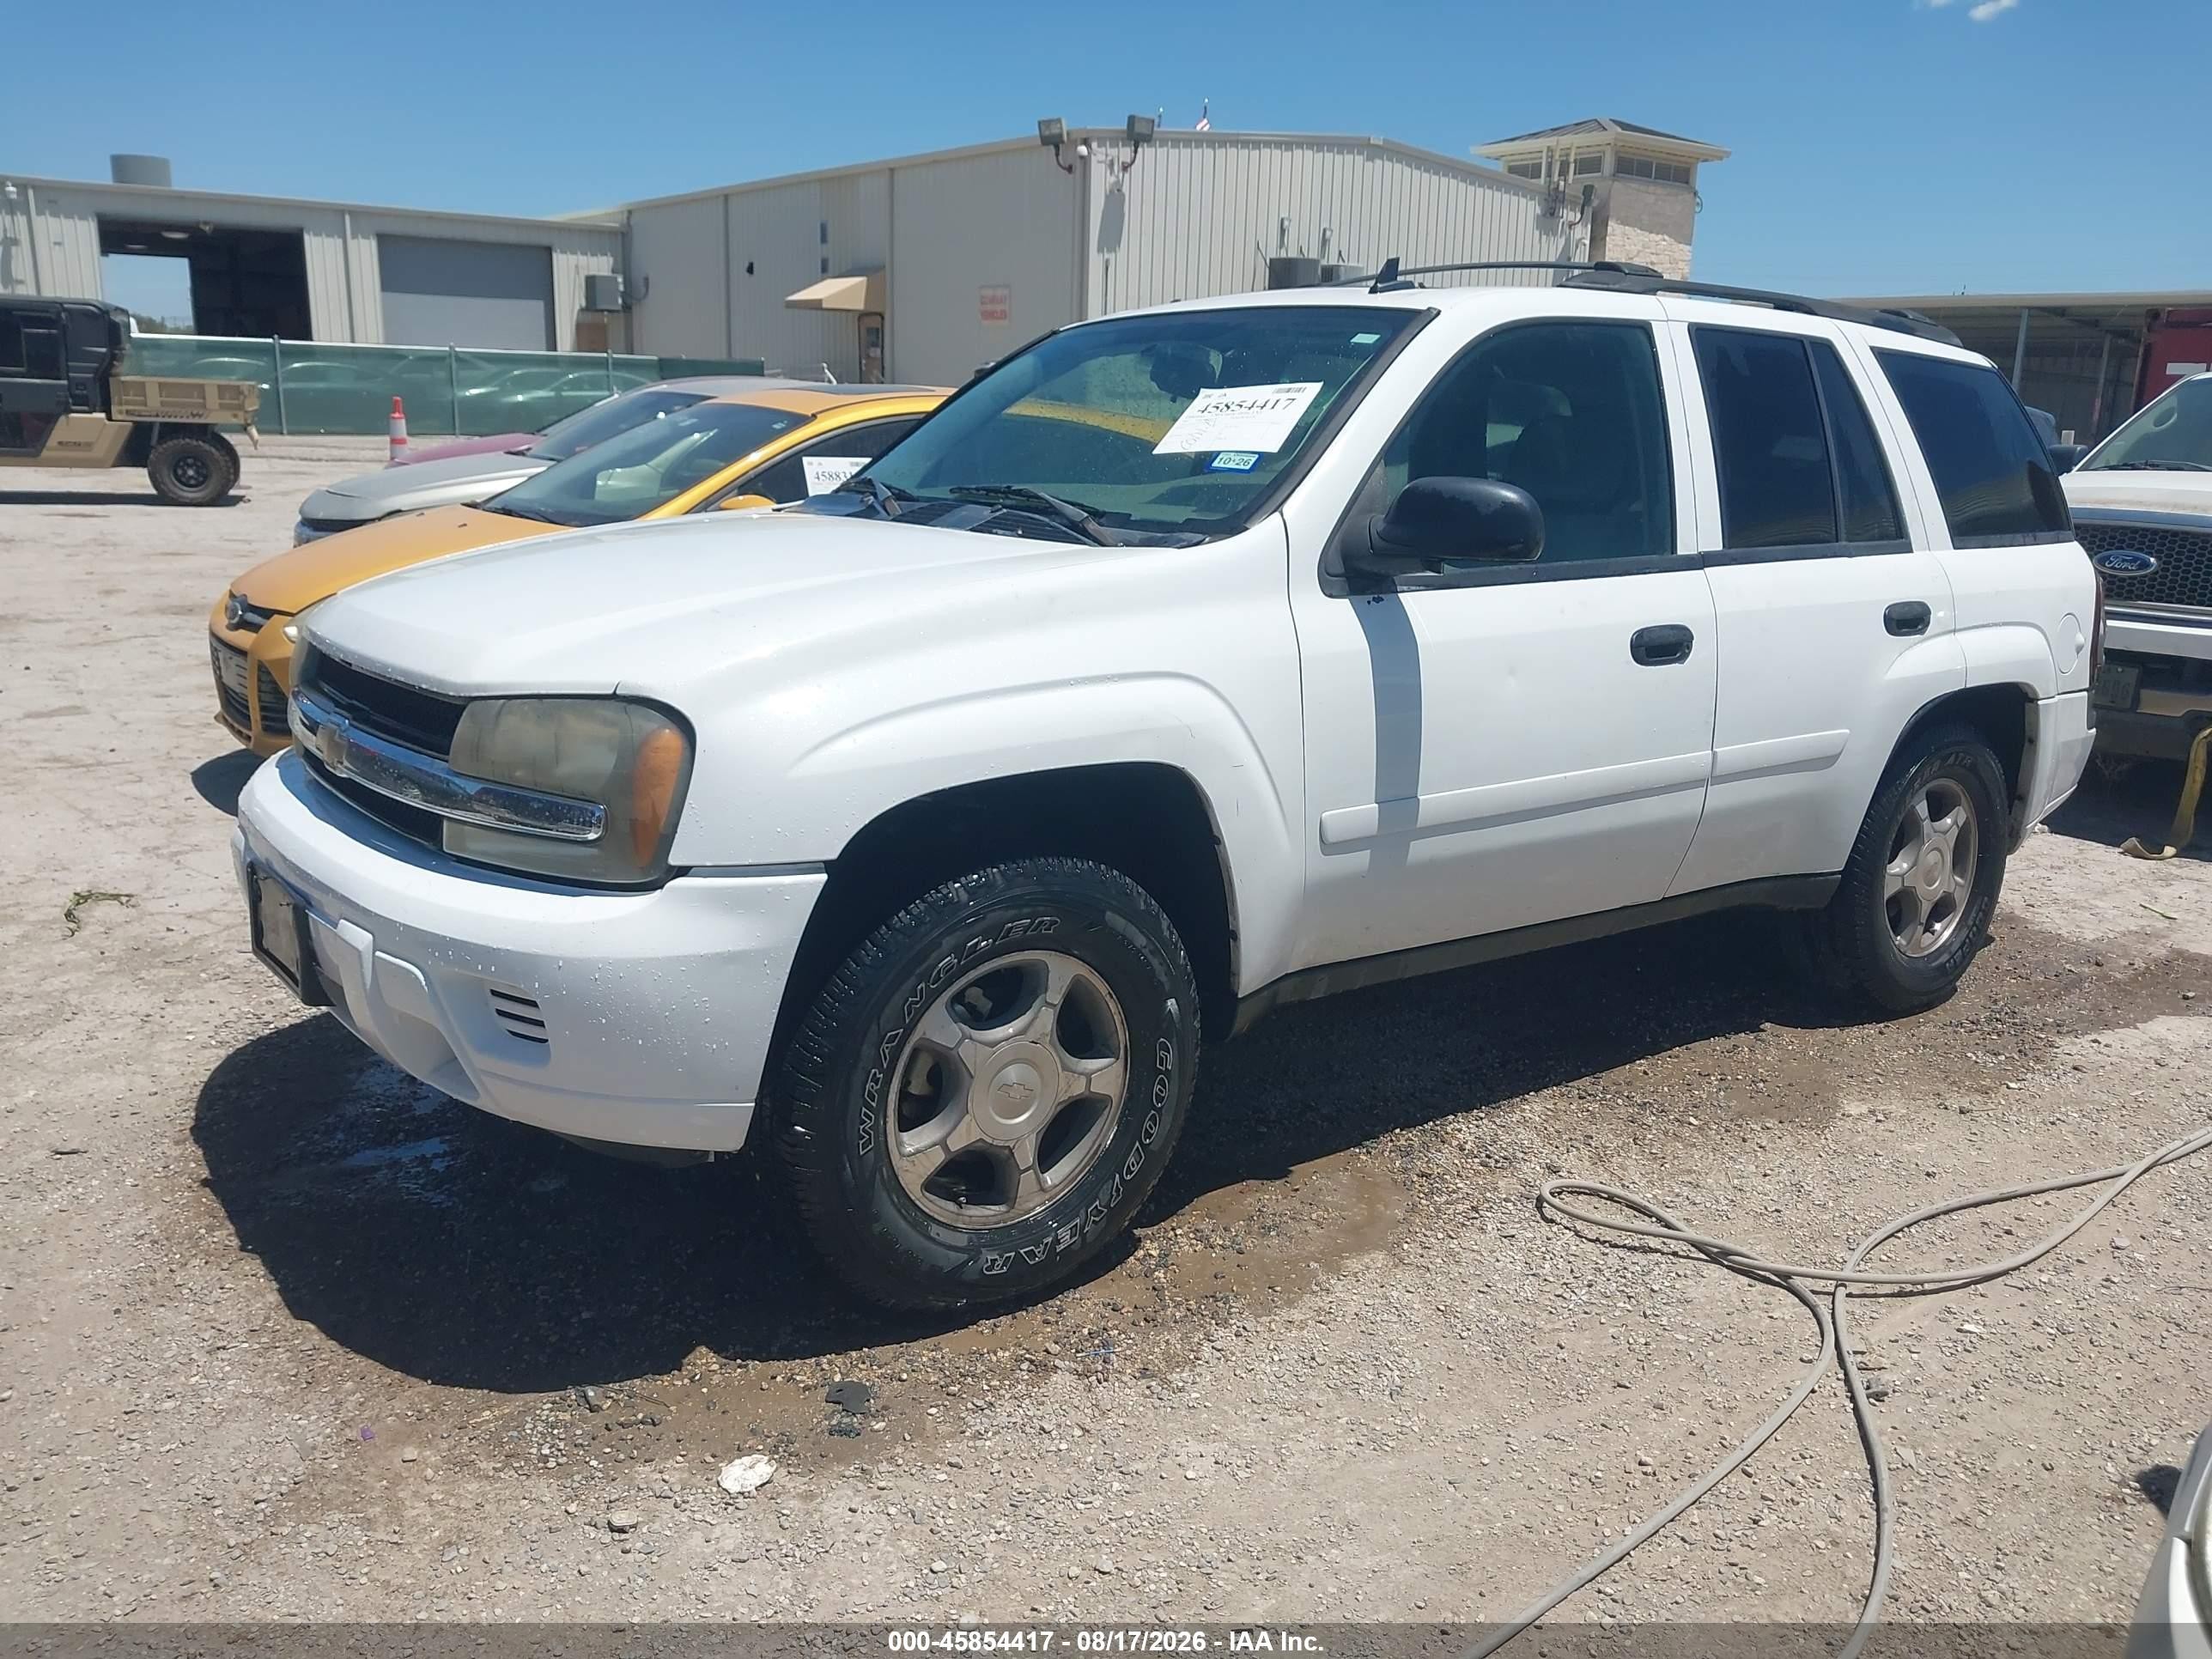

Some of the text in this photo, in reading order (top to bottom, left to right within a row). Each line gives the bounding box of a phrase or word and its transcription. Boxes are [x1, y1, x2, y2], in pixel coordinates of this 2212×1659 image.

[1198, 398, 1297, 414] 45854417
[2105, 555, 2142, 570] Ford
[859, 915, 1062, 1156] WRANGLER
[981, 1036, 1174, 1275] GOODYEAR
